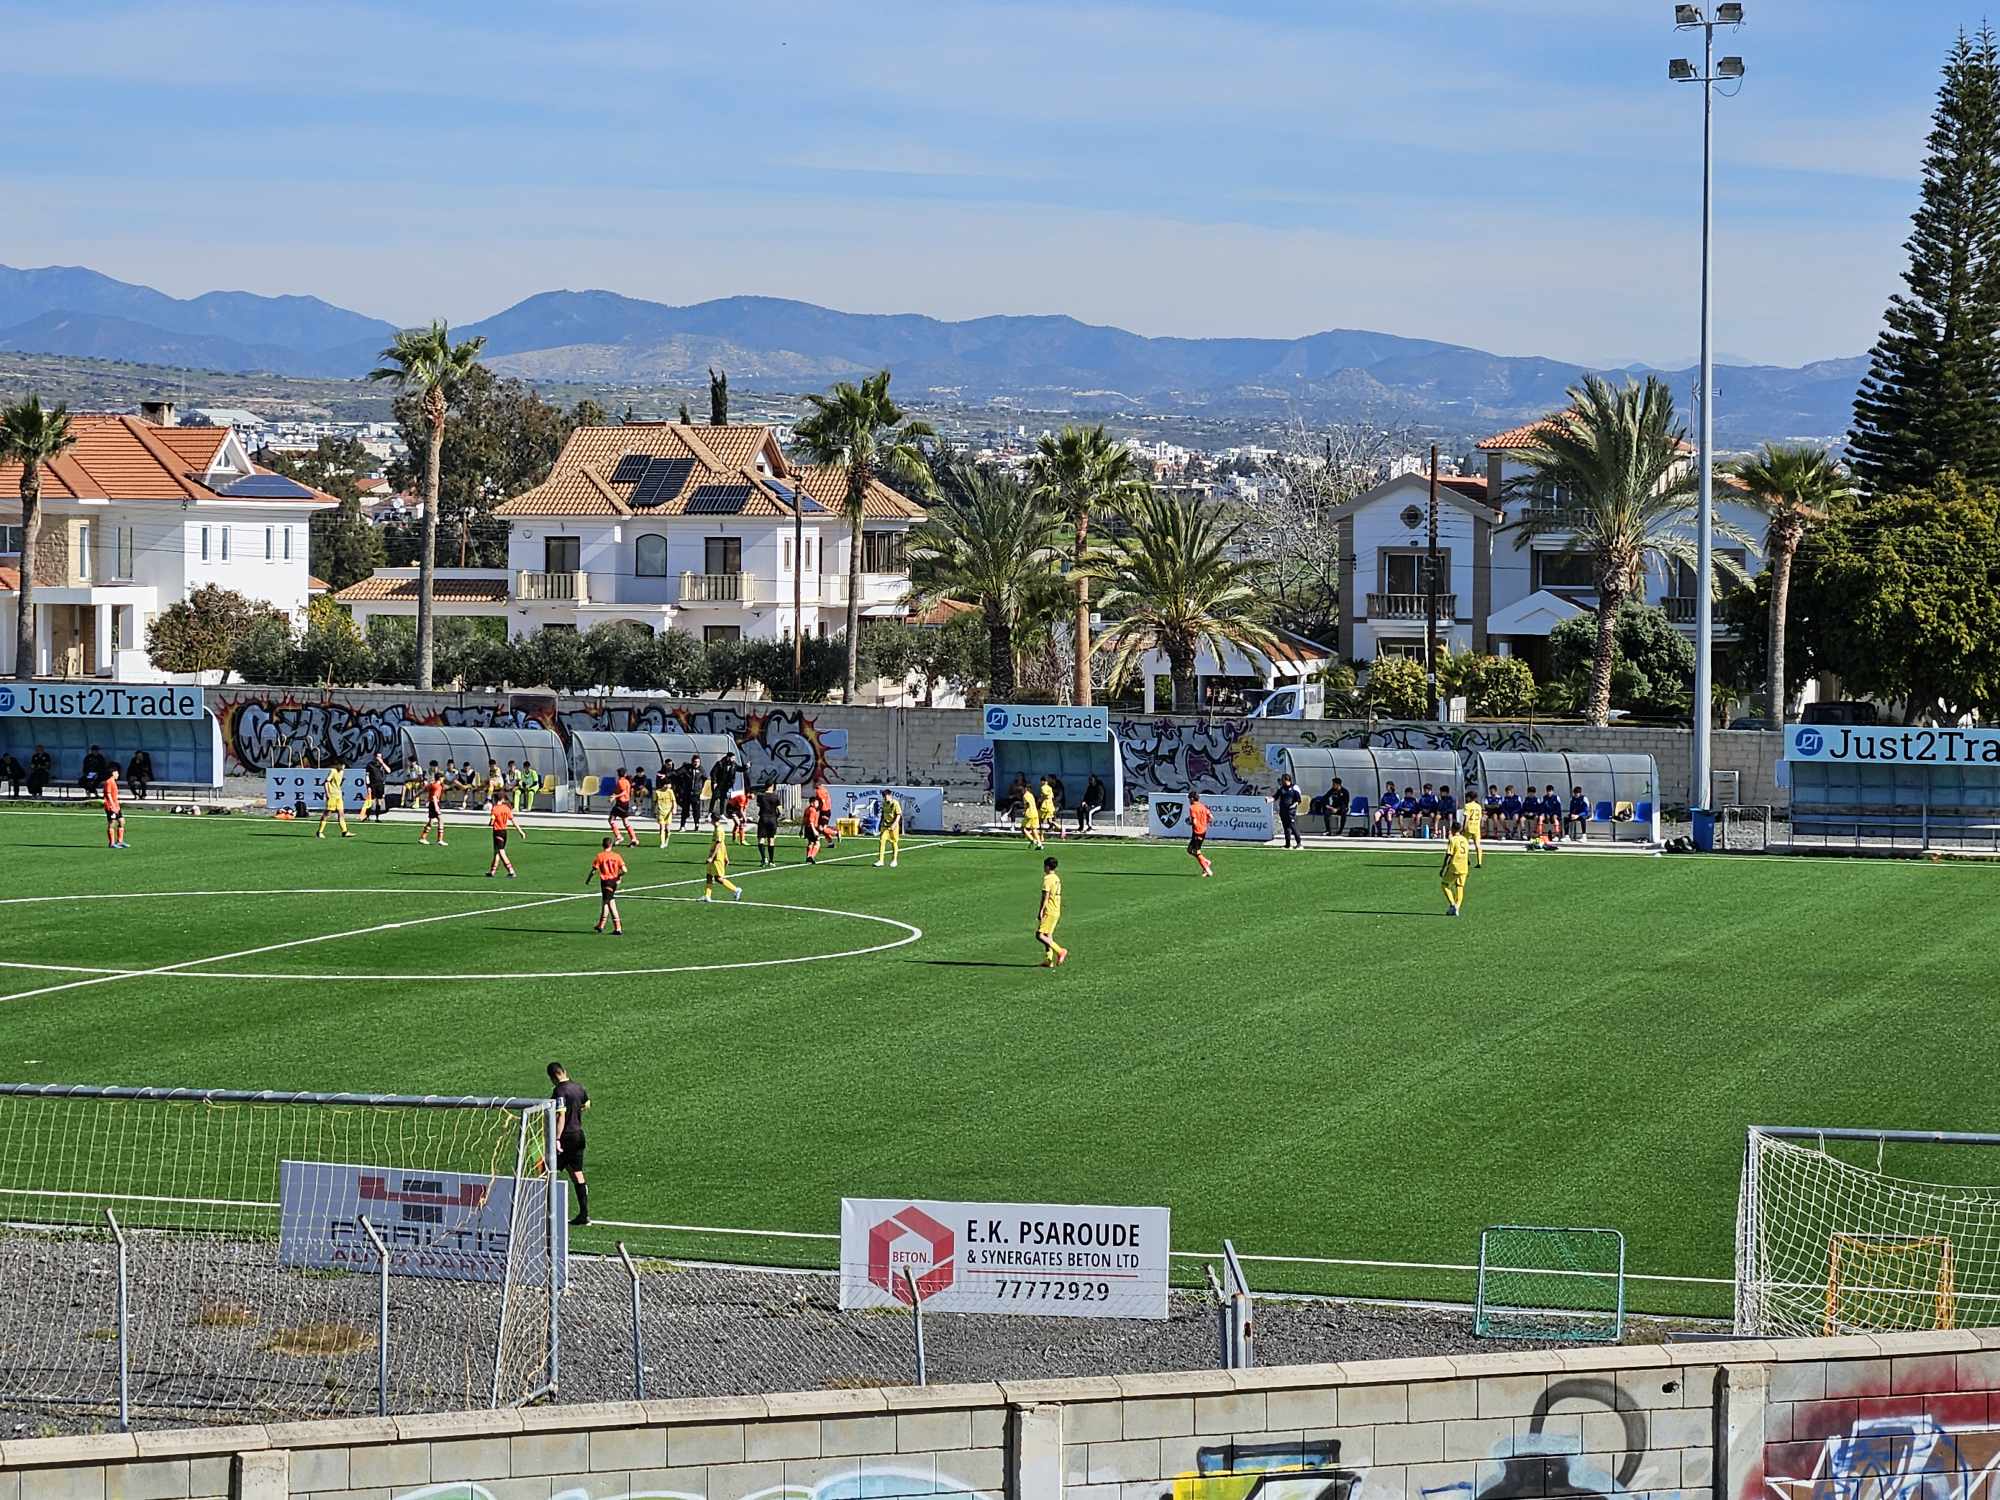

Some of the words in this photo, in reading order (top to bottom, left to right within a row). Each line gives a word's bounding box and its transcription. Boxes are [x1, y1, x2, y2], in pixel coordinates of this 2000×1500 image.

[21, 688, 195, 716] Just2Trade
[1012, 713, 1102, 729] Just2Trade
[273, 777, 365, 787] VOLO
[274, 791, 366, 801] PENA
[967, 1219, 1009, 1244] E.K.
[1019, 1221, 1141, 1247] PSAROUDE
[967, 1251, 977, 1264] &
[981, 1251, 1063, 1267] SYNERGATES
[1067, 1253, 1111, 1268] BETON
[1117, 1253, 1140, 1269] LTD
[995, 1279, 1110, 1302] 77772929
